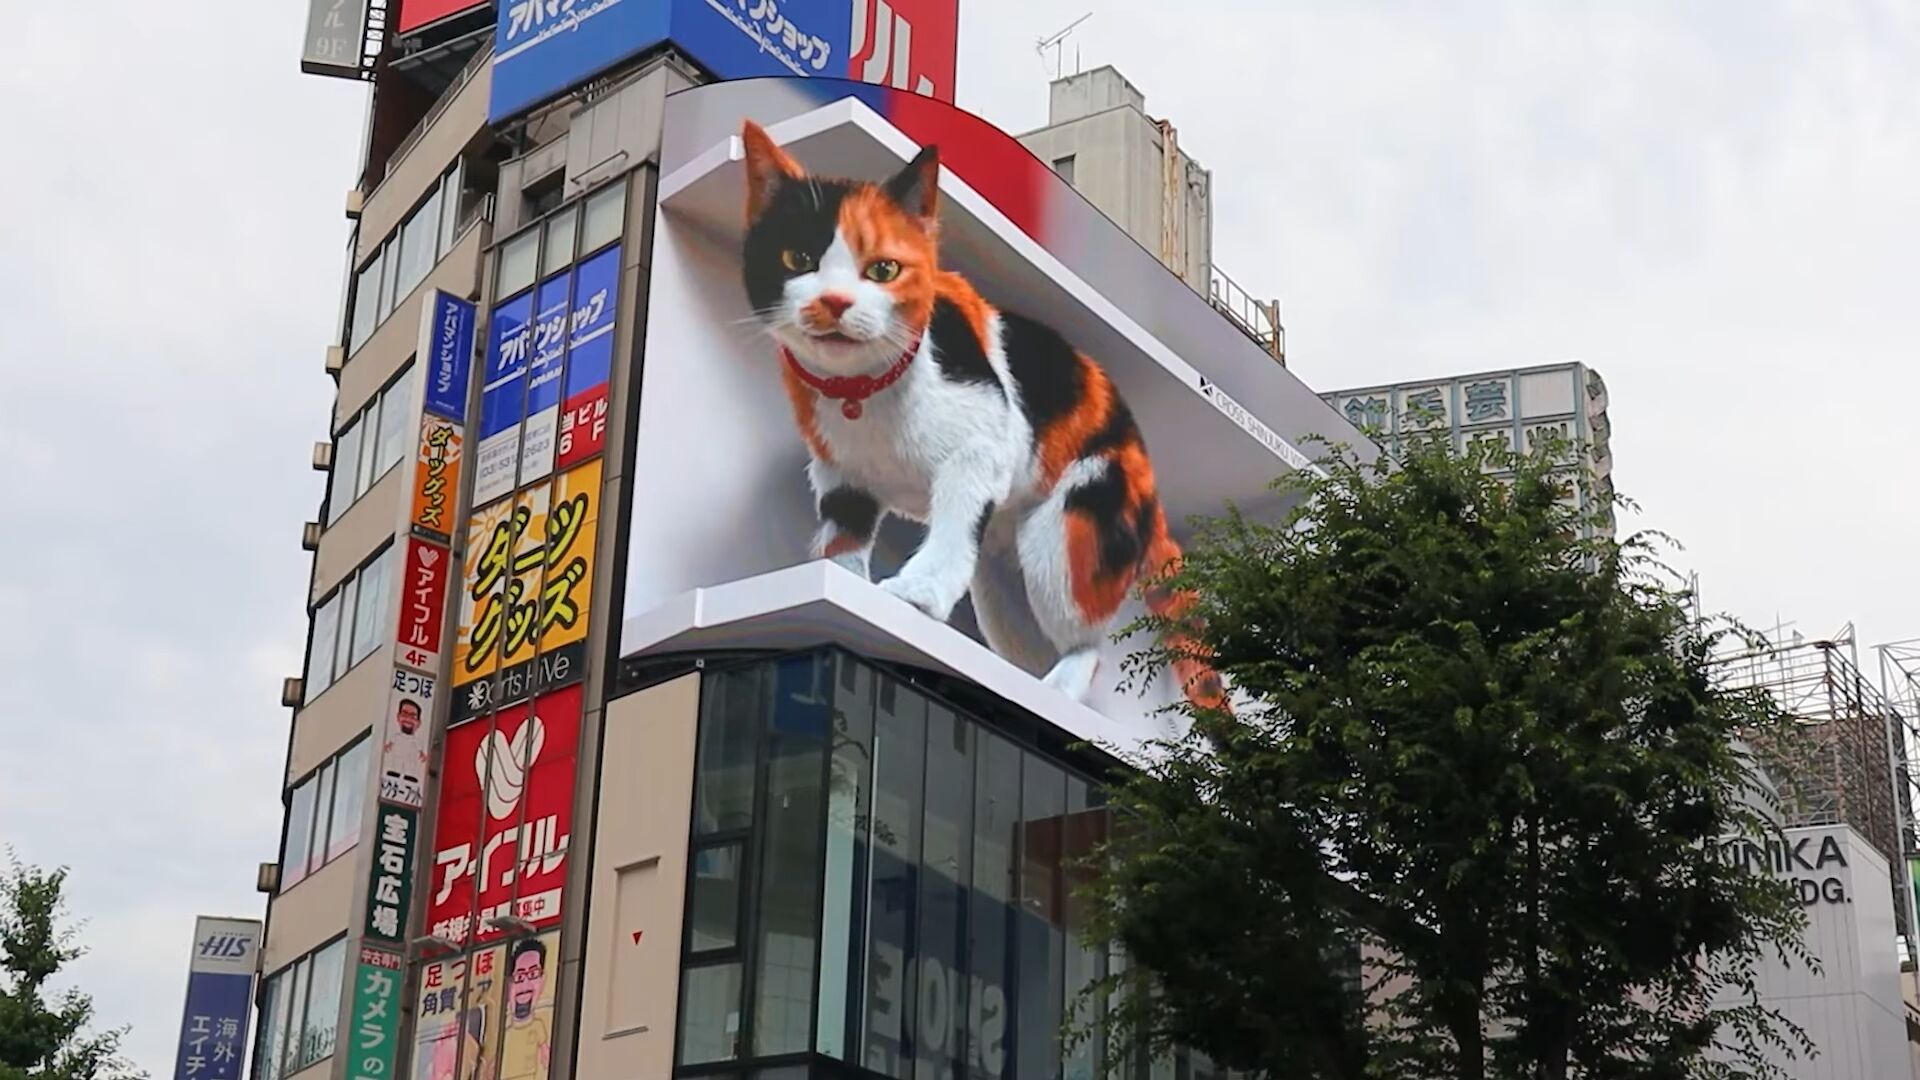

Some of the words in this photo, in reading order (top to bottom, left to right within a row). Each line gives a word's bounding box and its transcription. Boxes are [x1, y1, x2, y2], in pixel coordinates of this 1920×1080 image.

[418, 425, 455, 528] ダーツグッズ
[473, 493, 589, 601] ダーツ
[409, 567, 436, 646] アイフル
[465, 557, 588, 672] グッズ
[393, 669, 435, 699] 足つぼ
[406, 650, 428, 667] 4F
[371, 813, 409, 938] 宝石広場
[435, 814, 570, 906] アイフル
[199, 935, 252, 958] HIS
[213, 1016, 239, 1080] 海外・
[355, 971, 393, 1080] カメラの
